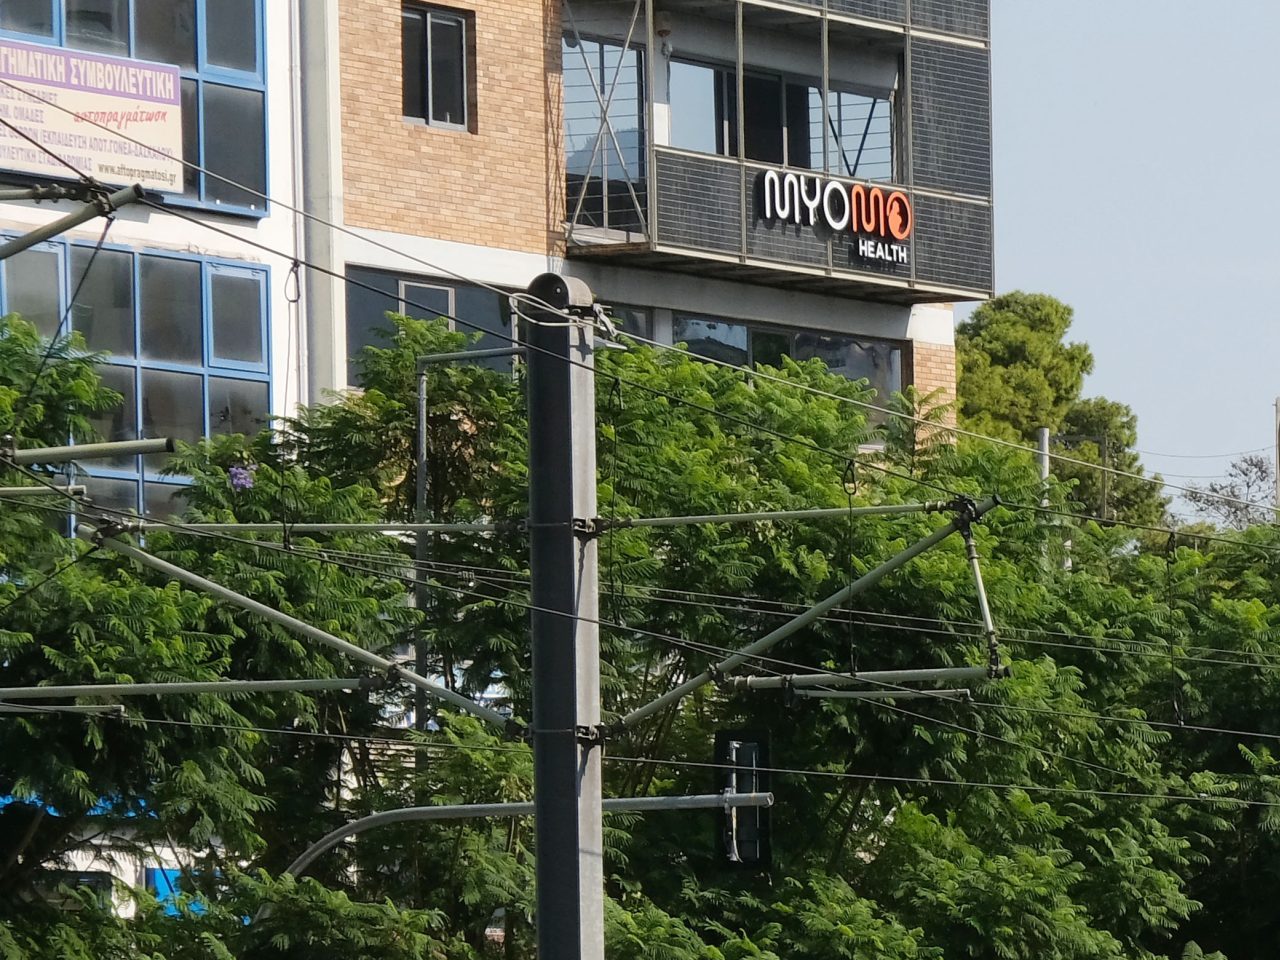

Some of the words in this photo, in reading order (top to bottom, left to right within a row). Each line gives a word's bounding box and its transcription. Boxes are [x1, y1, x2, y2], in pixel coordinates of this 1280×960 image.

[70, 57, 174, 99] ΣΥΜΒΟΥΛΕΥΤΙΚΗ
[98, 163, 176, 186] www.aftopragmatosi.gr
[858, 239, 908, 263] HEALTH
